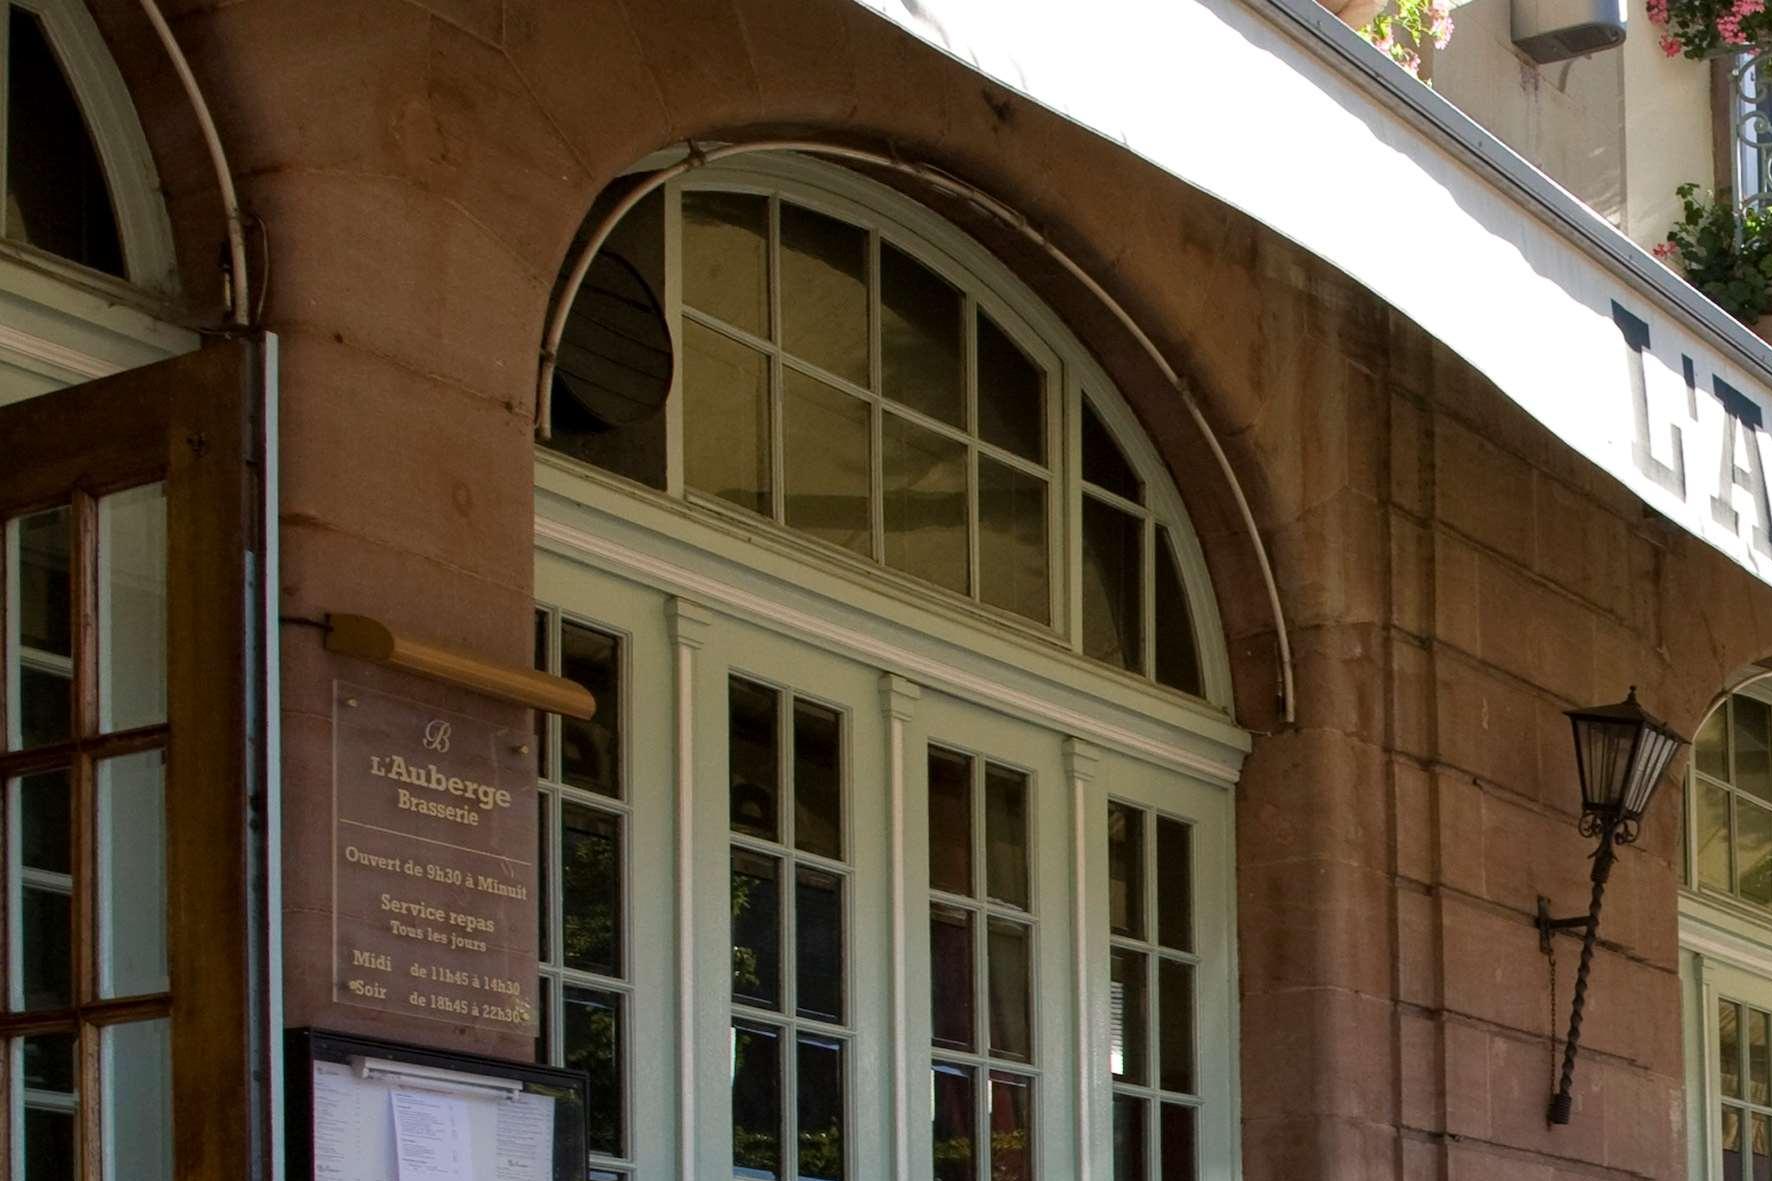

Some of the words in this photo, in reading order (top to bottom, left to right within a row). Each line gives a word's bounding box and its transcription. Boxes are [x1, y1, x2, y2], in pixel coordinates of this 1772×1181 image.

[370, 755, 512, 810] L'Auberge
[397, 788, 480, 826] Brasserie
[345, 846, 401, 872] Ouvert
[403, 859, 424, 877] de
[426, 864, 462, 885] 9h30
[465, 873, 475, 889] à
[477, 875, 528, 901] Minuit
[380, 893, 446, 922] Service
[449, 913, 496, 932] repas
[390, 920, 424, 937] Tous
[427, 927, 448, 945] les
[450, 932, 488, 952] jours
[352, 949, 393, 972] Midi
[410, 962, 427, 980] de
[431, 966, 469, 986] 11h45
[471, 974, 481, 989] à
[483, 975, 521, 996] 14h30
[355, 979, 388, 1000] Soir
[409, 991, 426, 1007] de
[430, 994, 469, 1015] 18h45
[471, 1001, 480, 1017] à
[482, 1004, 521, 1024] 22h30
